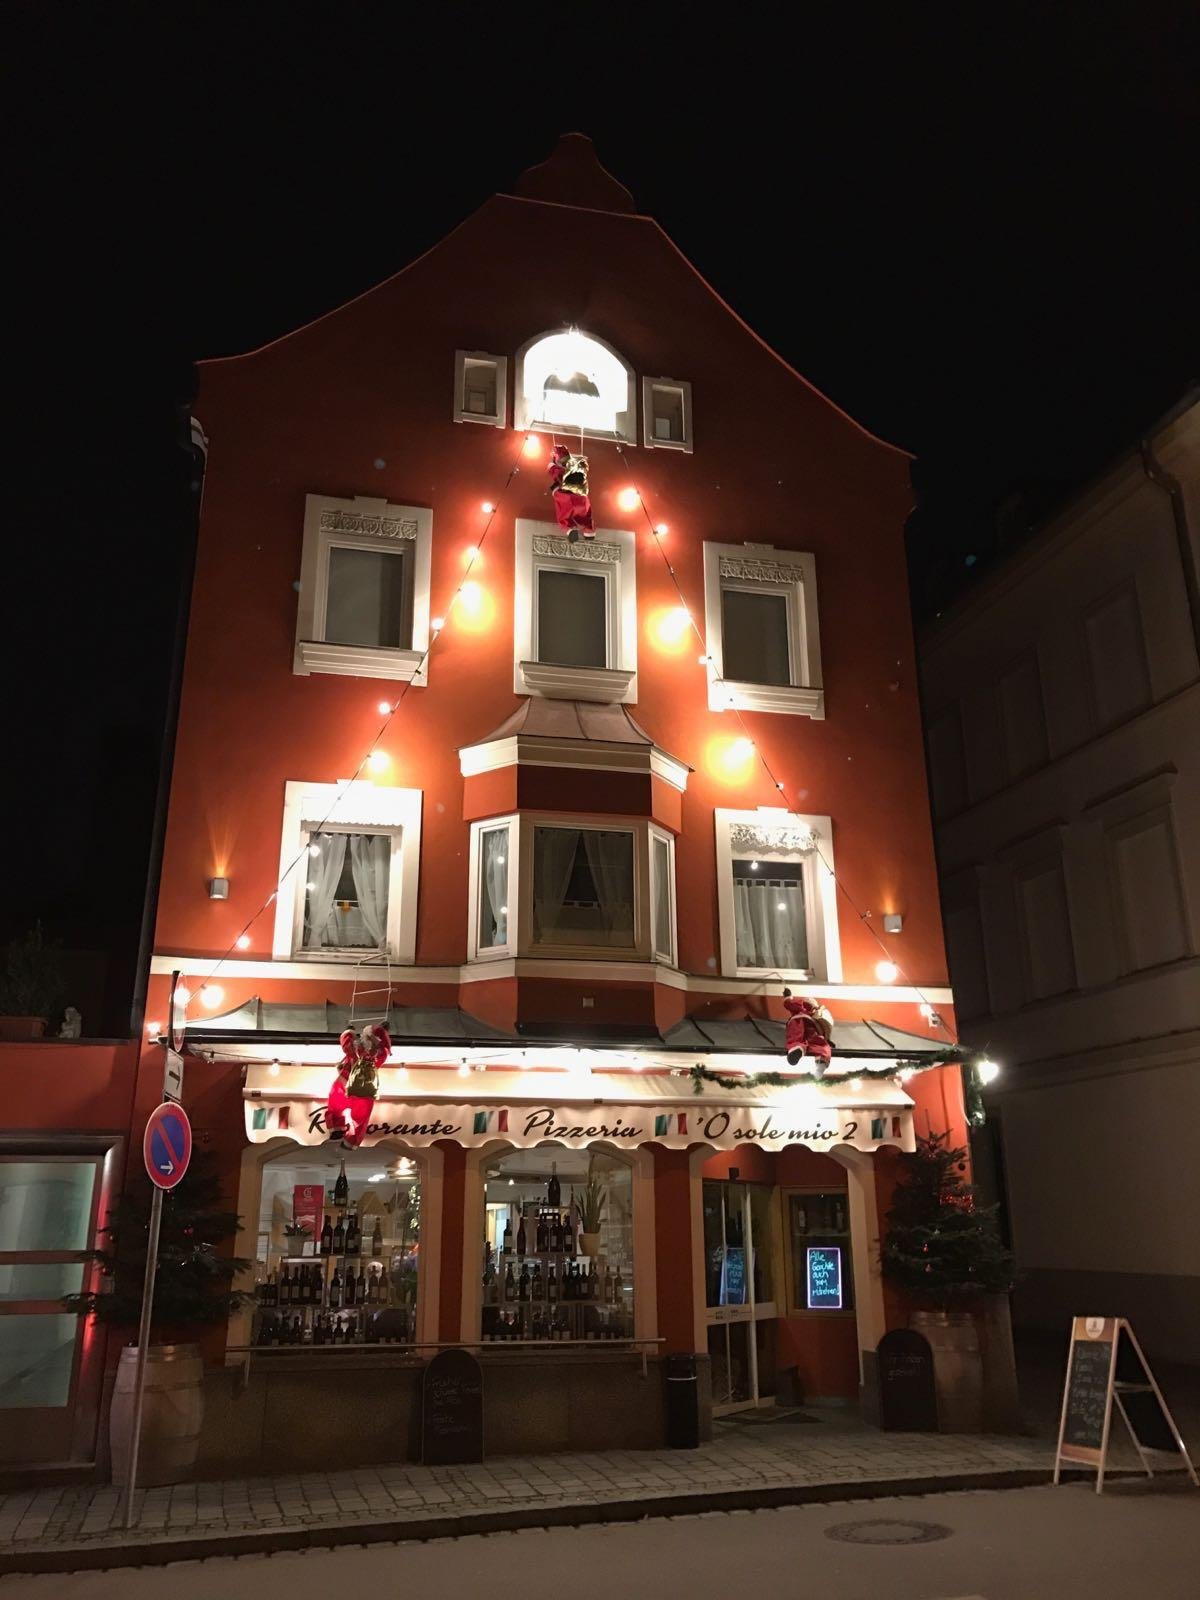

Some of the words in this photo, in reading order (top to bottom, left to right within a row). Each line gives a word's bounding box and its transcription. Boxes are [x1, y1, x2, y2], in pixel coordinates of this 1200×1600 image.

[308, 1105, 462, 1136] Rorante
[522, 1108, 644, 1138] Pizzeria
[733, 1115, 786, 1140] sole
[788, 1121, 839, 1140] mio
[841, 1122, 857, 1140] 2
